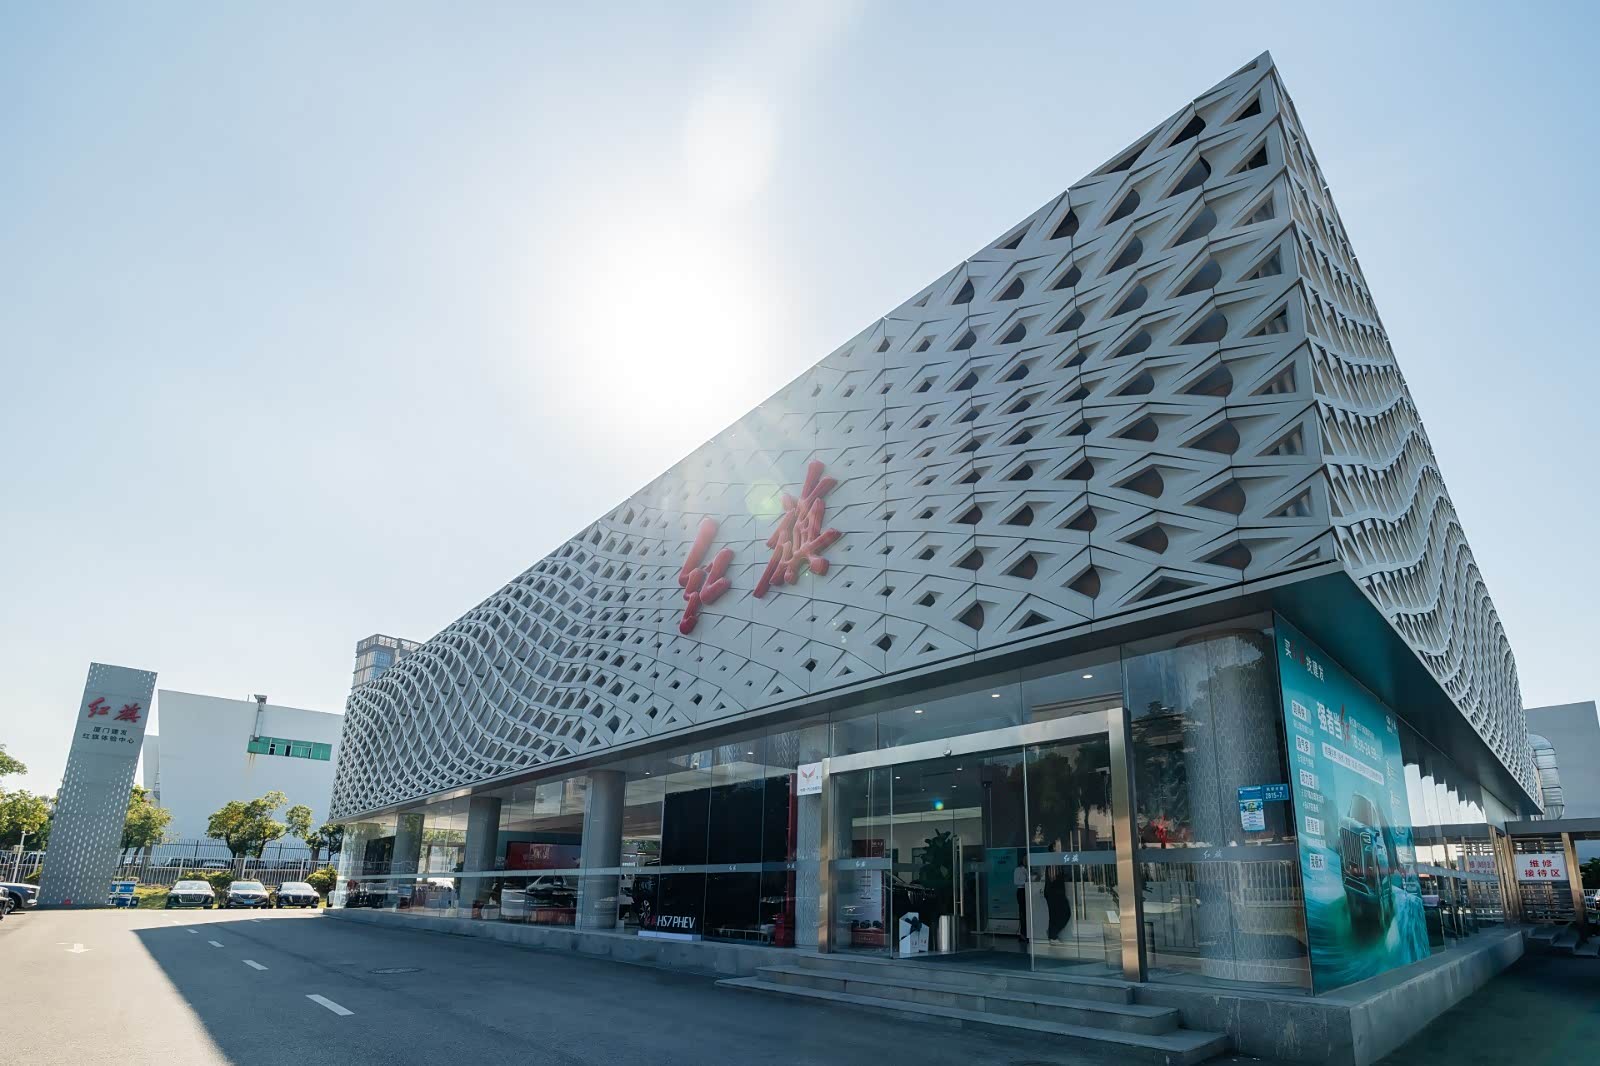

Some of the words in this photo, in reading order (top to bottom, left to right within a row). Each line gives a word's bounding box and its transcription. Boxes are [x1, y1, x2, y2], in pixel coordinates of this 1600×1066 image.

[679, 459, 842, 635] 红旗
[88, 697, 141, 723] 红旗
[93, 726, 128, 736] 厦门建发
[82, 733, 135, 744] 红旗体验中心
[1529, 859, 1552, 868] 维修
[1525, 869, 1560, 878] 接待区
[657, 915, 673, 927] HS7
[672, 916, 696, 929] PHEV
